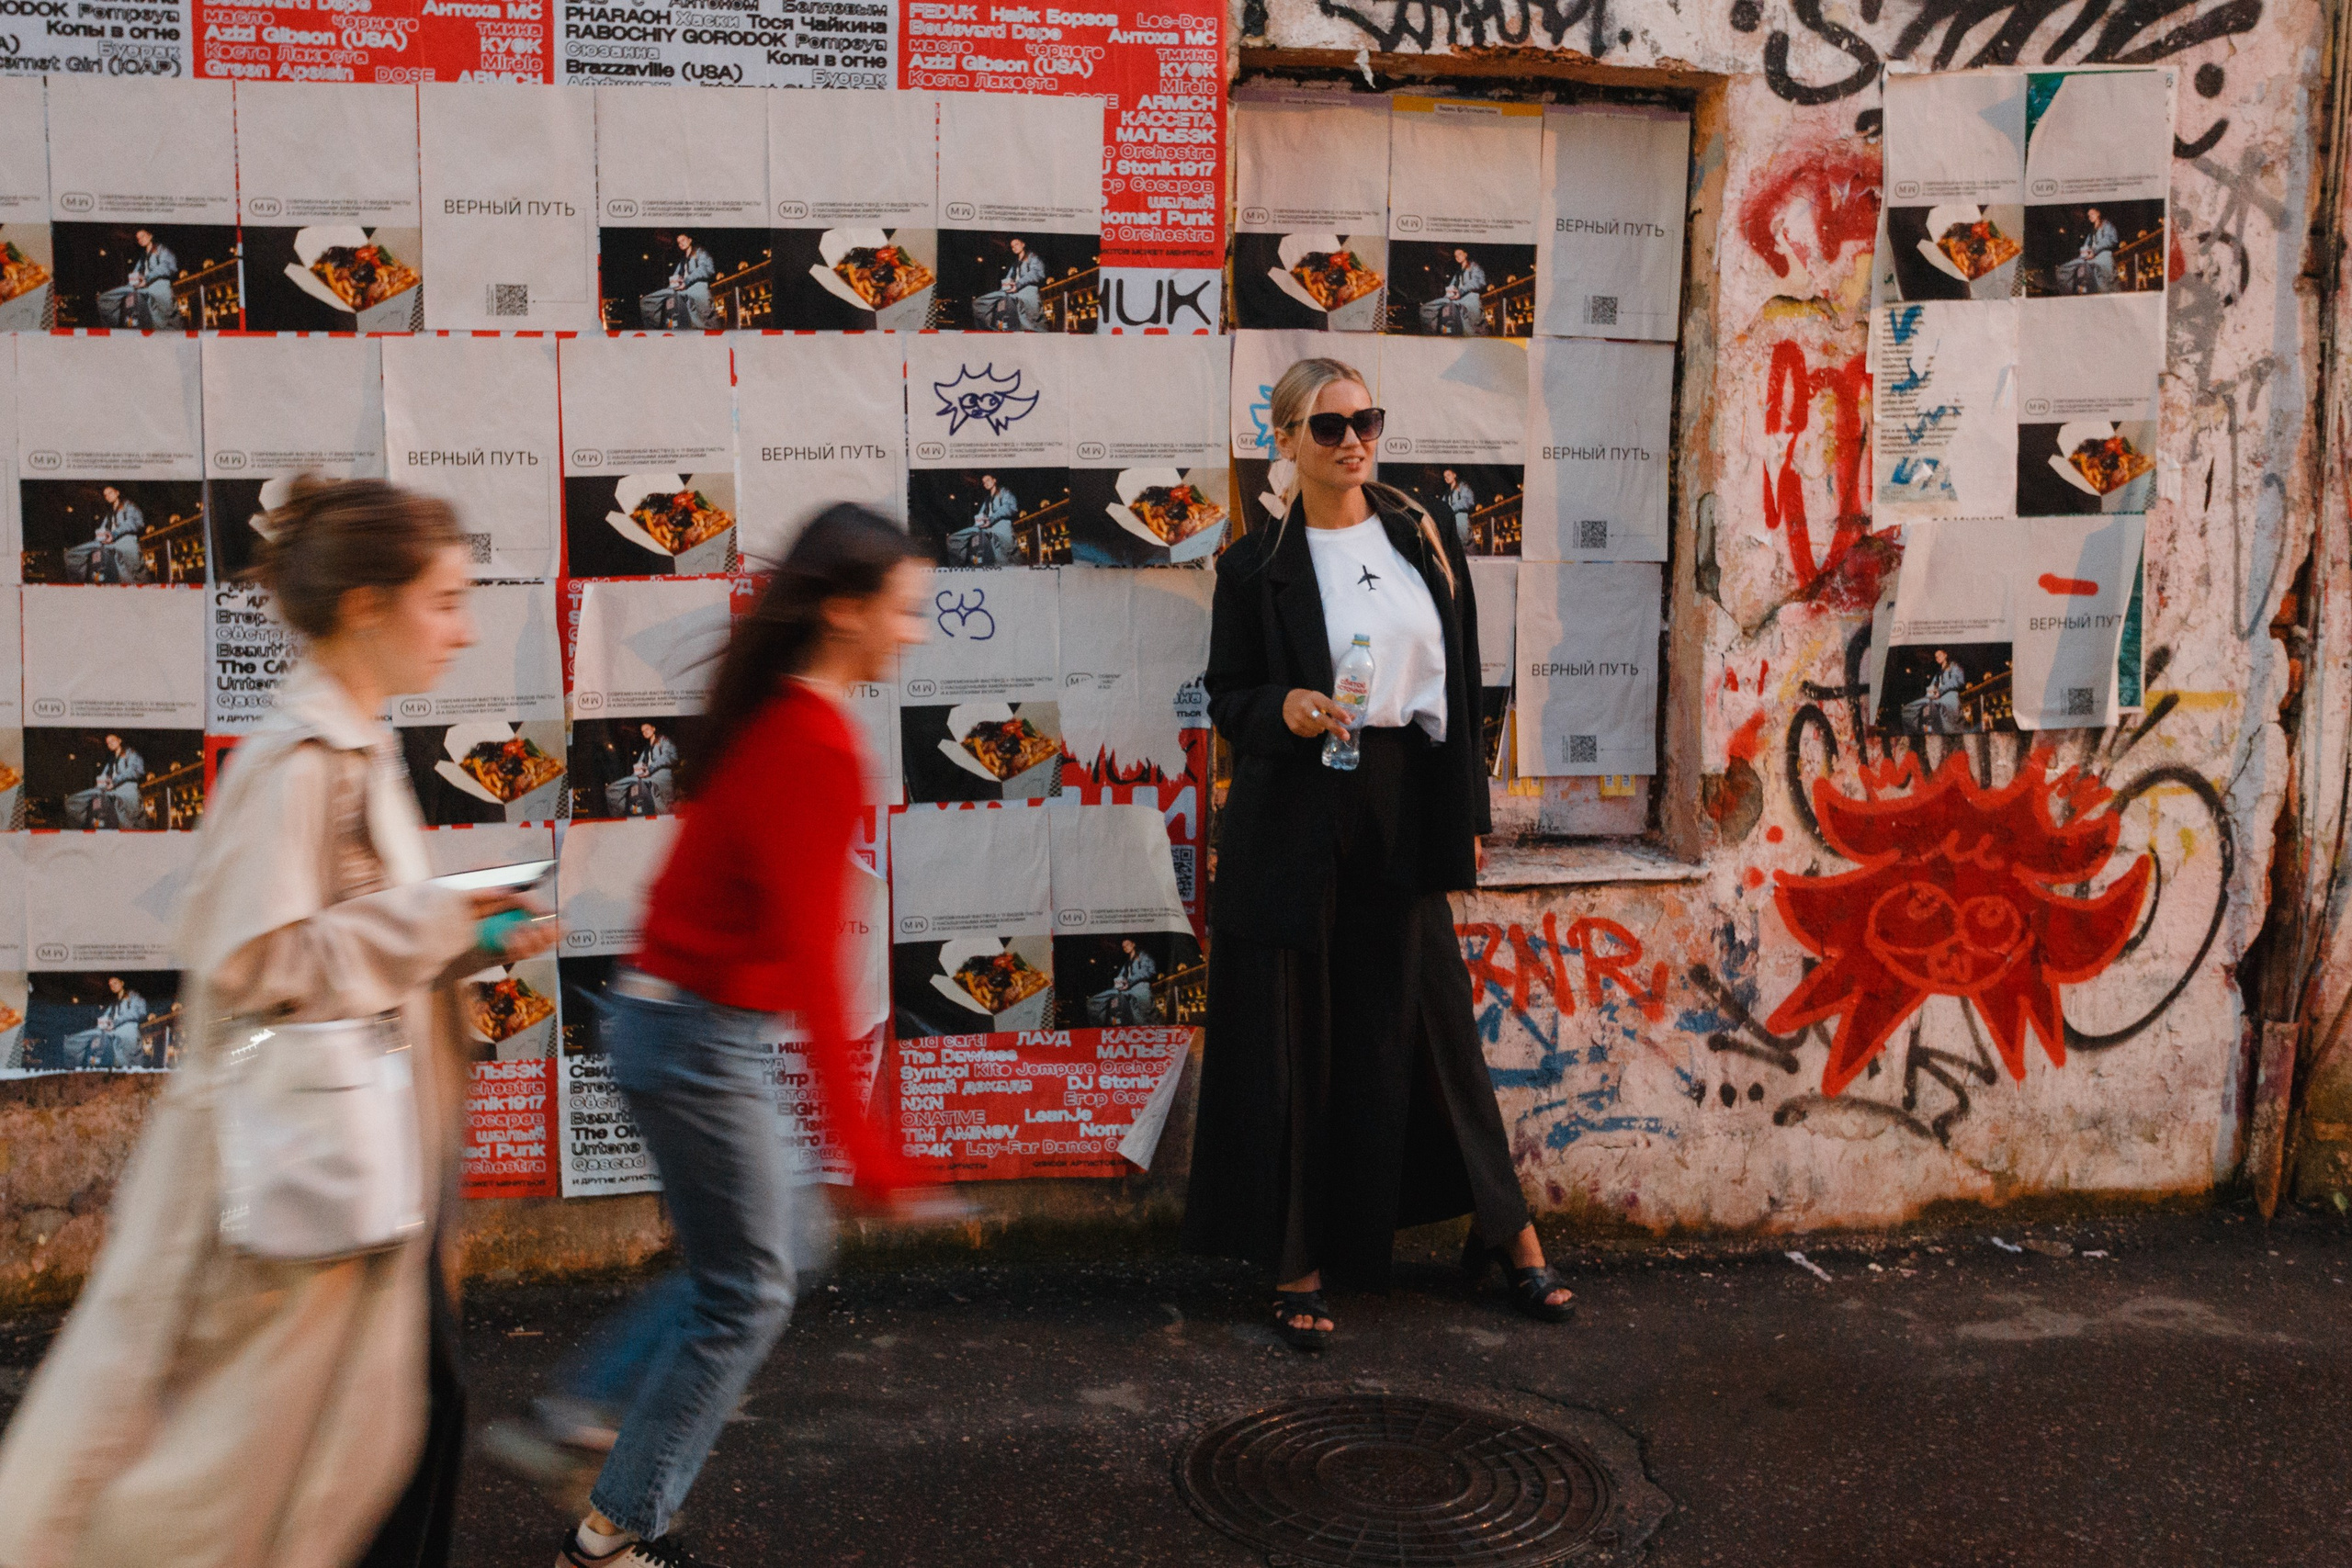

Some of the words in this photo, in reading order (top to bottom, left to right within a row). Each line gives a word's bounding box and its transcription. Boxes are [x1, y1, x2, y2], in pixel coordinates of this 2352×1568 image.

[0, 2, 69, 17] ODOK
[203, 9, 275, 26] масло
[422, 0, 501, 18] Антоха
[565, 6, 672, 25] PHARAOH
[909, 3, 978, 21] FEDUK
[990, 6, 1041, 24] Найк
[1046, 8, 1119, 28] Борзов
[46, 19, 105, 38] Копы
[130, 28, 181, 41] огне
[675, 10, 741, 28] Хаски
[746, 14, 794, 30] Тося
[801, 16, 888, 34] Чайкина
[909, 18, 1006, 39] Boulevard
[1136, 13, 1217, 31] Loc-Dog
[565, 24, 677, 43] RABOCHIY
[682, 28, 787, 48] GORODOK
[796, 33, 888, 54] Pompeya
[1107, 28, 1179, 45] Антоха
[565, 40, 661, 61] Сюзанна
[909, 39, 974, 54] масло
[766, 50, 819, 66] Копы
[824, 54, 836, 66] в
[841, 55, 888, 69] огне
[908, 53, 956, 70] Azizi
[962, 55, 1029, 73] Gibson
[1034, 57, 1094, 79] (USA)
[565, 59, 675, 78] Brazzaville
[682, 62, 743, 84] (USA)
[909, 70, 969, 87] Коста
[974, 73, 1058, 91] Лакоста
[1136, 95, 1217, 111] ARMICH
[1121, 110, 1217, 128] КАССЕТА
[1115, 127, 1217, 144] МАЛЬБЭК
[1119, 142, 1216, 161] Orchestra
[1116, 160, 1217, 177] Stonik1917
[444, 197, 523, 216] ВЕРНЫЙ
[528, 201, 576, 217] ПУТЬ
[1167, 210, 1216, 227] Punk
[1118, 225, 1216, 243] Orchestra
[1555, 217, 1620, 235] ВЕРНЫЙ
[1624, 222, 1665, 239] ПУТЬ
[408, 447, 484, 467] ВЕРНЫЙ
[491, 450, 538, 467] ПУТЬ
[762, 443, 834, 461] ВЕРНЫЙ
[841, 445, 886, 460] ПУТЬ
[1542, 444, 1605, 460] ВЕРНЫЙ
[1611, 447, 1650, 461] ПУТЬ
[2030, 614, 2091, 630] ВЕРНЫЙ
[2094, 615, 2122, 629] ПУТ
[216, 660, 256, 674] The
[1532, 660, 1594, 677] ВЕРНЫЙ
[1599, 662, 1639, 677] ПУТЬ
[842, 683, 879, 699] УТЬ
[838, 920, 869, 934] УТЬ
[1016, 1031, 1071, 1047] ЛАУД
[1102, 1028, 1192, 1043] КАССЕТА
[899, 1050, 936, 1065] The
[1096, 1044, 1179, 1059] МАЛЬБЭ
[468, 1063, 547, 1079] ЛЬБЭК
[899, 1065, 969, 1082] Symbol
[973, 1063, 1012, 1077] Kito
[1015, 1062, 1097, 1077] Jempere
[468, 1079, 546, 1096] chestra
[1067, 1076, 1093, 1090] DJ
[466, 1095, 547, 1111] onik1917
[900, 1096, 944, 1111] NXN
[1064, 1091, 1108, 1109] Егор
[900, 1110, 986, 1127] ONATIVE
[571, 1126, 608, 1141] The
[900, 1127, 936, 1143] TIM
[942, 1124, 1020, 1142] AMINOV
[496, 1143, 546, 1158] Punk
[901, 1142, 954, 1157] SP4K
[967, 1139, 1039, 1158] Lay-Far
[1042, 1138, 1102, 1155] Dance
[461, 1157, 546, 1175] rchestra
